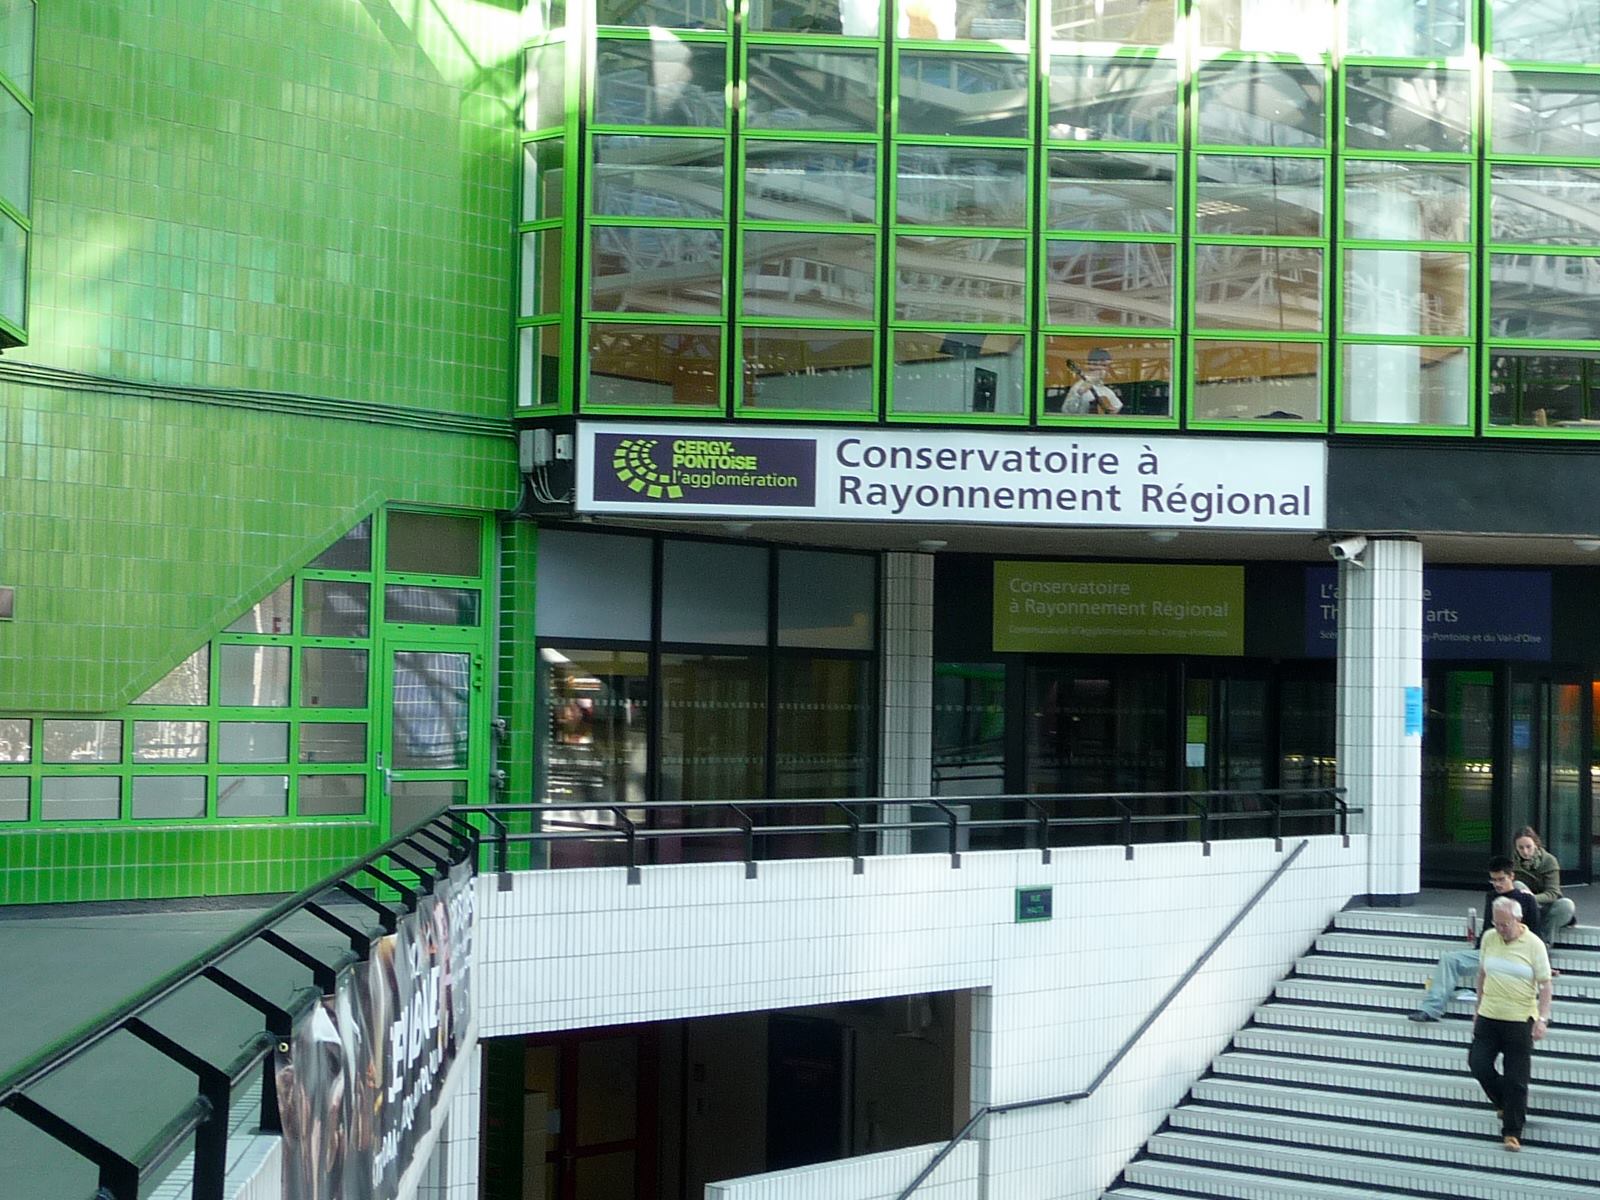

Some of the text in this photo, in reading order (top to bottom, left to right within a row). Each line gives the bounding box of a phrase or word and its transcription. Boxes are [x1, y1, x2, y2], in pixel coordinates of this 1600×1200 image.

[673, 439, 736, 455] CERGY-
[836, 438, 1159, 475] Conservatoire à
[672, 469, 798, 488] l'agglomération
[839, 475, 1311, 523] Rayonnement Régional
[1008, 577, 1131, 596] Conservatoire
[1008, 598, 1229, 620] à Rayonnement Régional
[1426, 608, 1459, 623] arts
